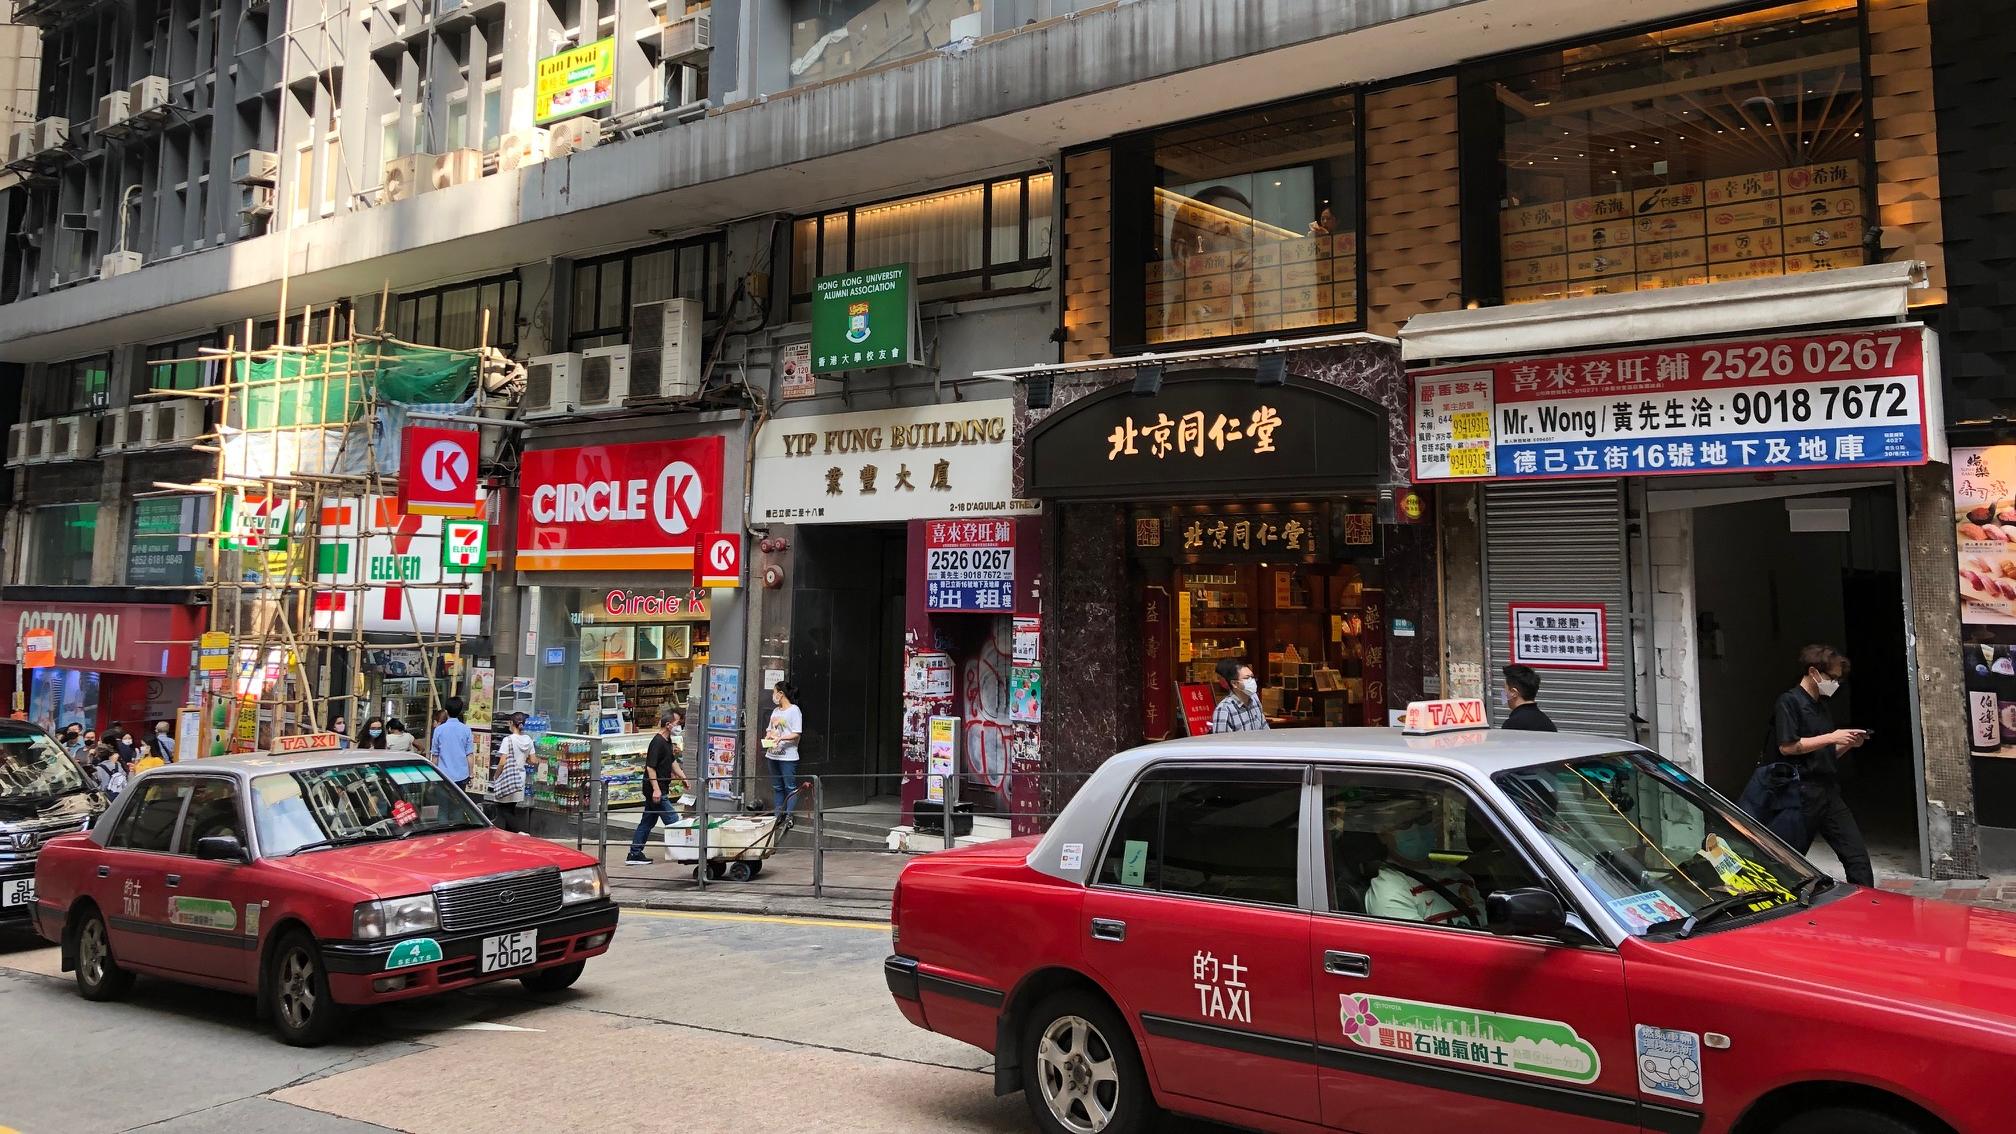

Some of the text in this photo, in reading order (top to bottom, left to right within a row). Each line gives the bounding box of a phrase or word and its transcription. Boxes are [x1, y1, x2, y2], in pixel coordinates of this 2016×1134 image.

[818, 270, 903, 291] HONG KONG UNIVERSITY
[824, 282, 896, 300] ALUMNI ASSOCIATION
[818, 347, 899, 367] 香港大學校友會
[1511, 336, 1901, 392] 喜來登旺鋪 2526 0267
[1503, 409, 1533, 435] Mr.
[1538, 406, 1596, 437] Wong
[1732, 388, 1811, 426] 9018
[1820, 383, 1908, 421] 7672
[782, 417, 1006, 457] YIP FUNG BUILDING
[1107, 405, 1283, 461] 北京同仁堂
[1514, 434, 1865, 474] 德己立街16號地下及地庫
[533, 479, 648, 524] CIRCLE
[950, 500, 1040, 512] 2-18 D'AGUILAR STRE
[932, 522, 1010, 543] 喜來登旺鋪
[1183, 519, 1305, 550] 北京同仁堂
[932, 550, 1010, 570] 2526 0267
[963, 571, 981, 579] 9018
[983, 571, 1001, 579] 7672
[606, 589, 706, 616] Circle K
[929, 582, 938, 607] 特約
[1002, 582, 1011, 608] 代理
[91, 613, 119, 661] ON
[1428, 701, 1480, 726] TAXI
[281, 735, 336, 750] TAXI
[11, 891, 31, 904] 86
[17, 880, 34, 892] SL
[124, 878, 141, 897] 的士
[123, 897, 140, 918] TAXI
[410, 945, 420, 956] 4
[498, 933, 521, 951] KF
[397, 955, 431, 966] SEATS
[486, 947, 533, 971] 7002
[1193, 949, 1248, 988] 的士
[1194, 984, 1252, 1024] TAXI
[1378, 1027, 1509, 1067] 豐田石油氣的士
